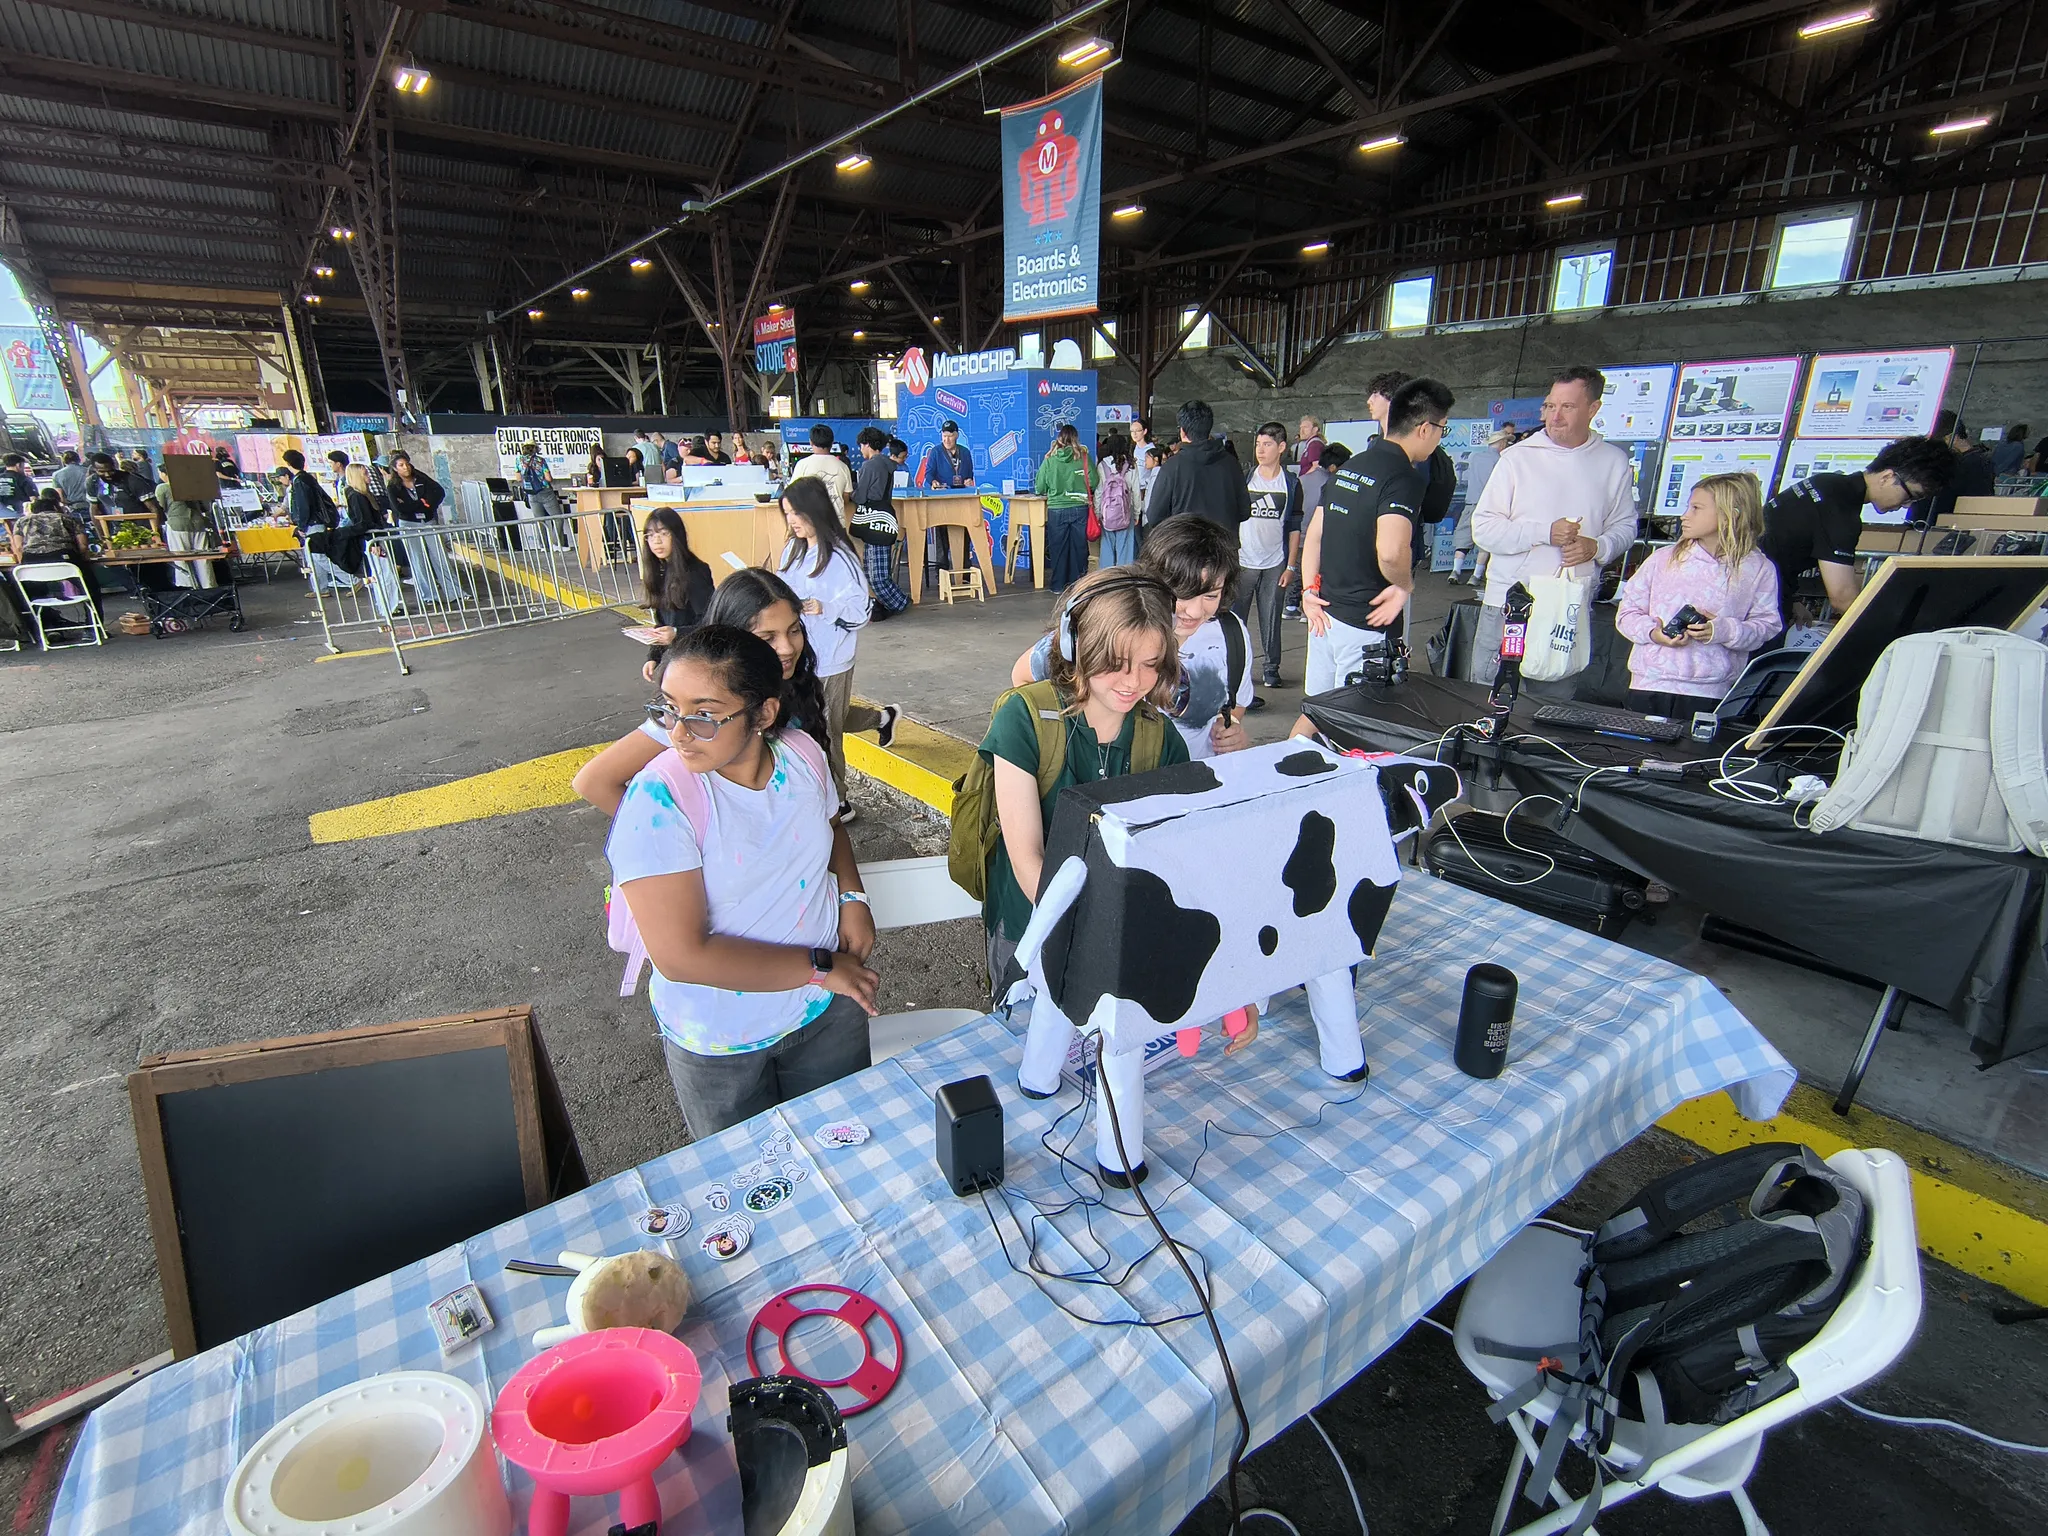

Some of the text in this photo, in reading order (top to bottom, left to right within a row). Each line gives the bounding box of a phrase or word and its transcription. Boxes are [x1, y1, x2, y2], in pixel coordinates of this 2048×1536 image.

[1041, 146, 1055, 169] M
[1017, 244, 1081, 276] Boards &
[1012, 273, 1087, 302] Electronics
[761, 315, 794, 335] Maker Shed
[756, 341, 787, 374] STORE
[933, 349, 1014, 379] MICROCHIP
[1051, 382, 1088, 393] MICROCHIP
[936, 390, 967, 413] Creativity
[498, 429, 530, 442] BUILD
[532, 429, 600, 442] ELECTRONICS
[500, 443, 543, 456] CHAE
[544, 443, 564, 455] THE
[1250, 507, 1280, 518] didas
[869, 521, 896, 535] Earth
